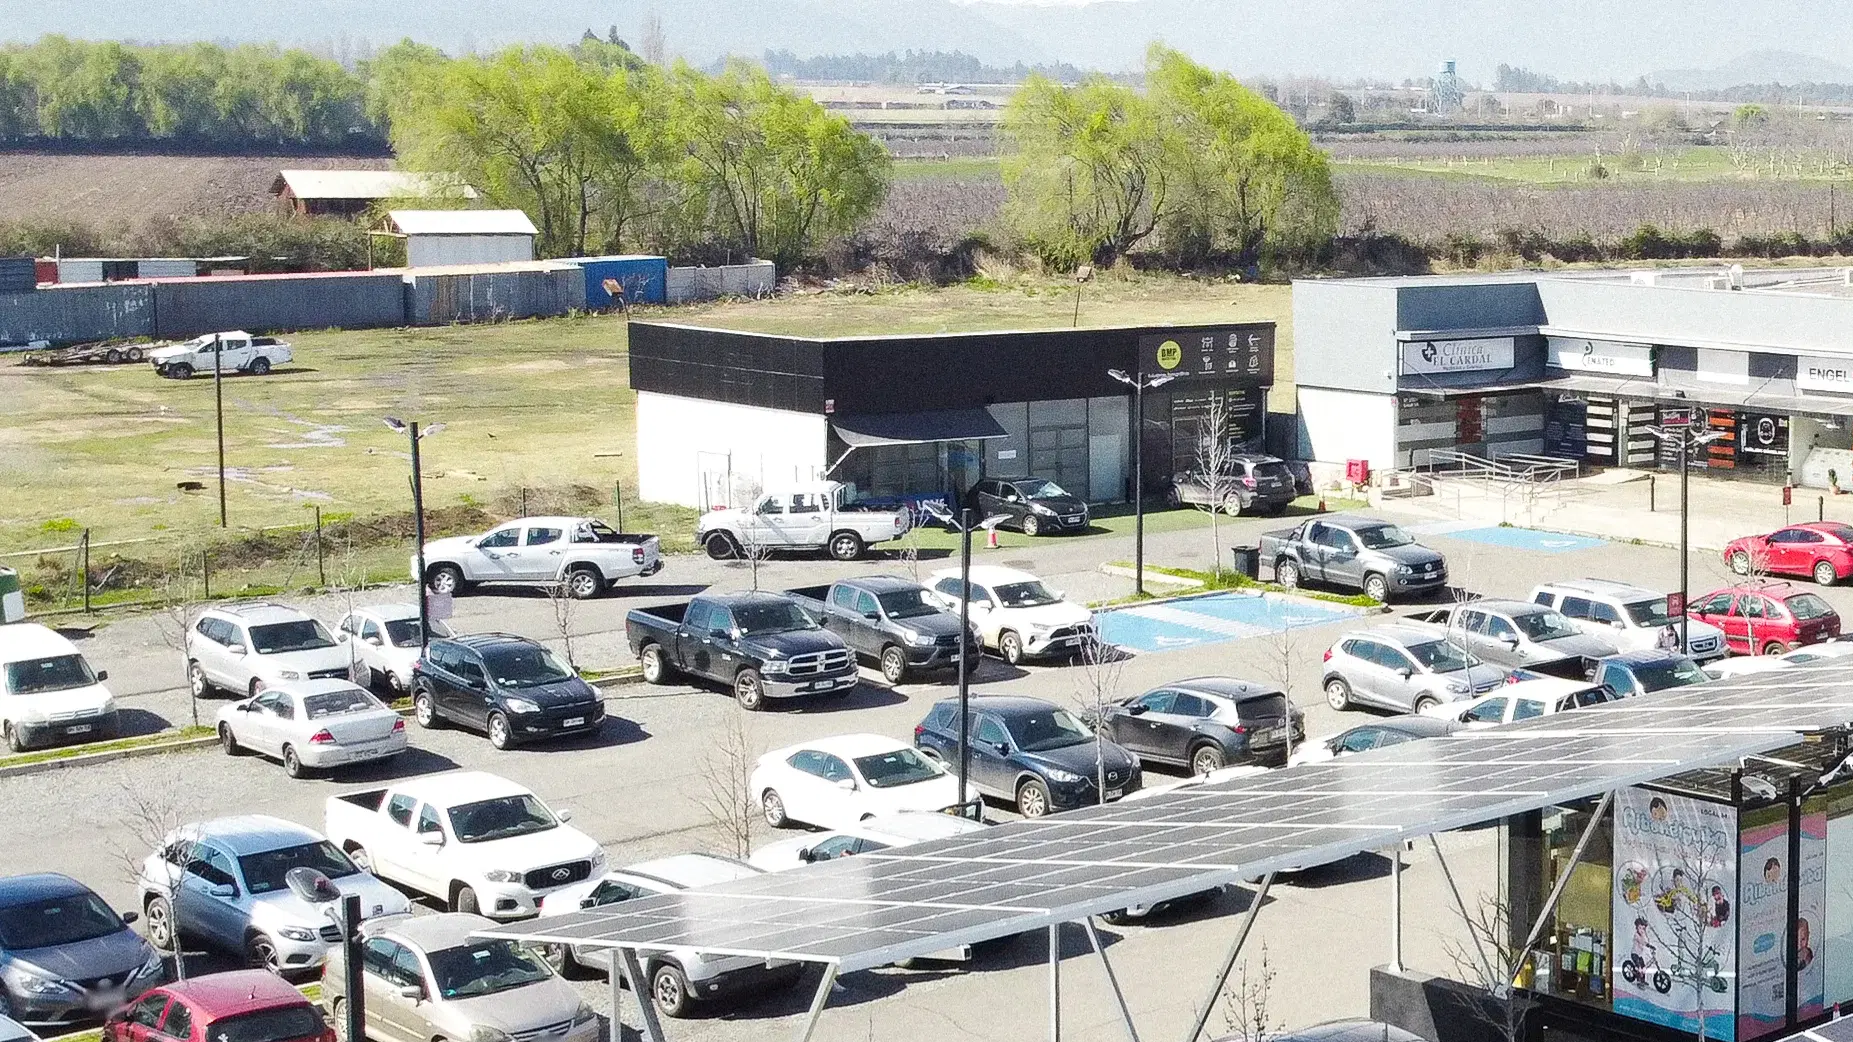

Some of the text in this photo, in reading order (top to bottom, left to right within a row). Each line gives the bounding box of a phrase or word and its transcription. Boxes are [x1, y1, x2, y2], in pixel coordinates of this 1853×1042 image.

[1433, 354, 1493, 366] EL CARDAL
[1809, 368, 1850, 383] ENGEL
